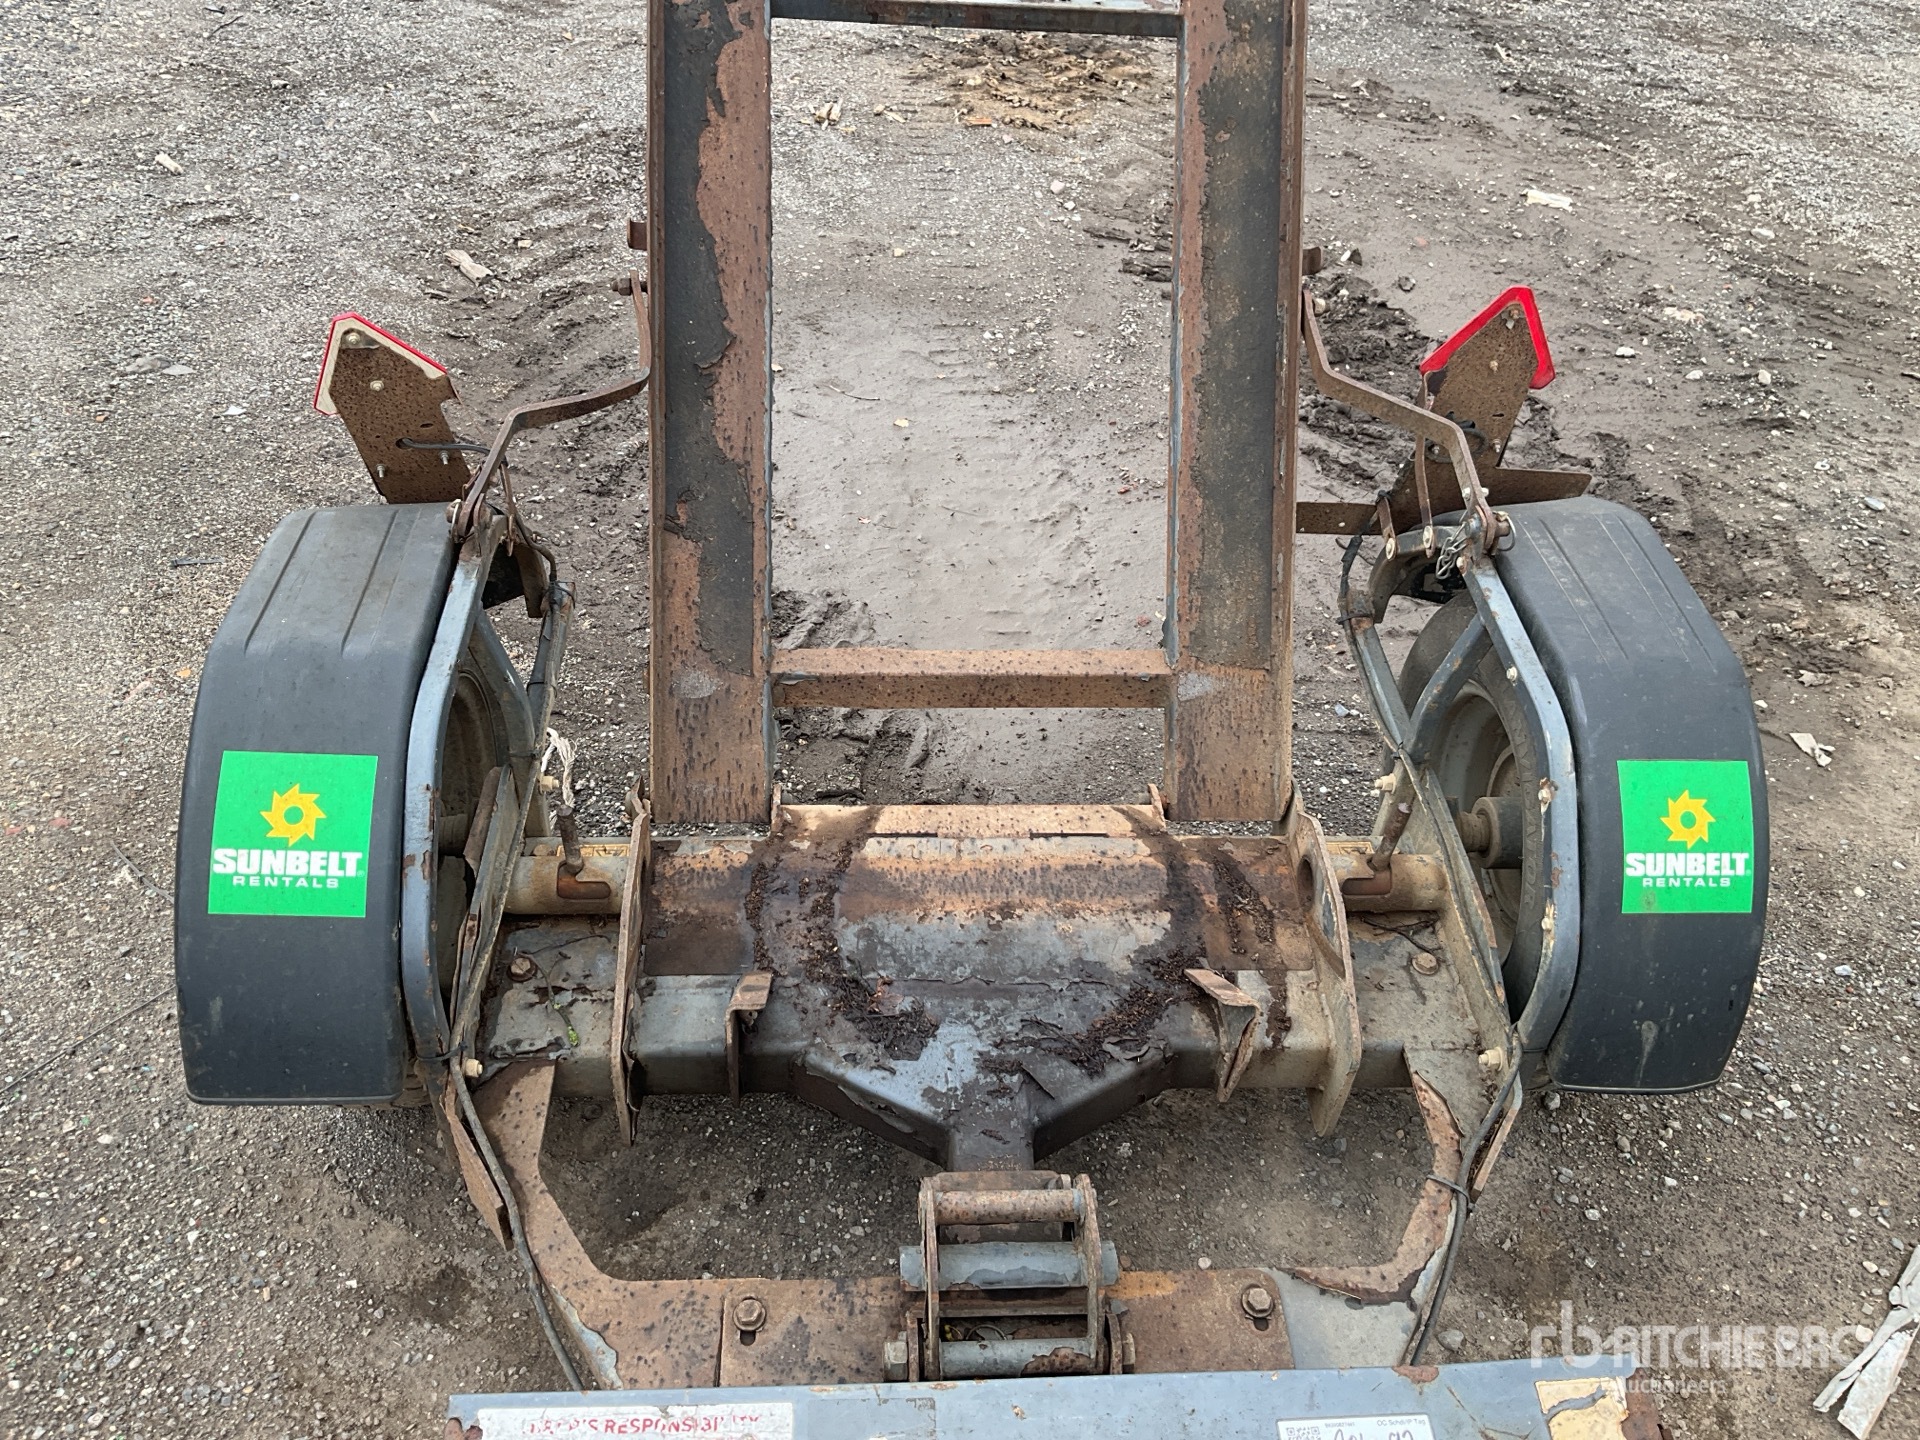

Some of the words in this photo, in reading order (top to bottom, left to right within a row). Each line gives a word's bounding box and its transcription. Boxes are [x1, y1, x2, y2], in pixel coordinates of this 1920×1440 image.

[212, 848, 364, 877] SUNBELT
[1625, 852, 1750, 876] SUNBELT
[232, 875, 339, 889] RENTALS
[1642, 877, 1731, 888] RENTALS
[603, 1415, 758, 1435] RESPONSIBIITY
